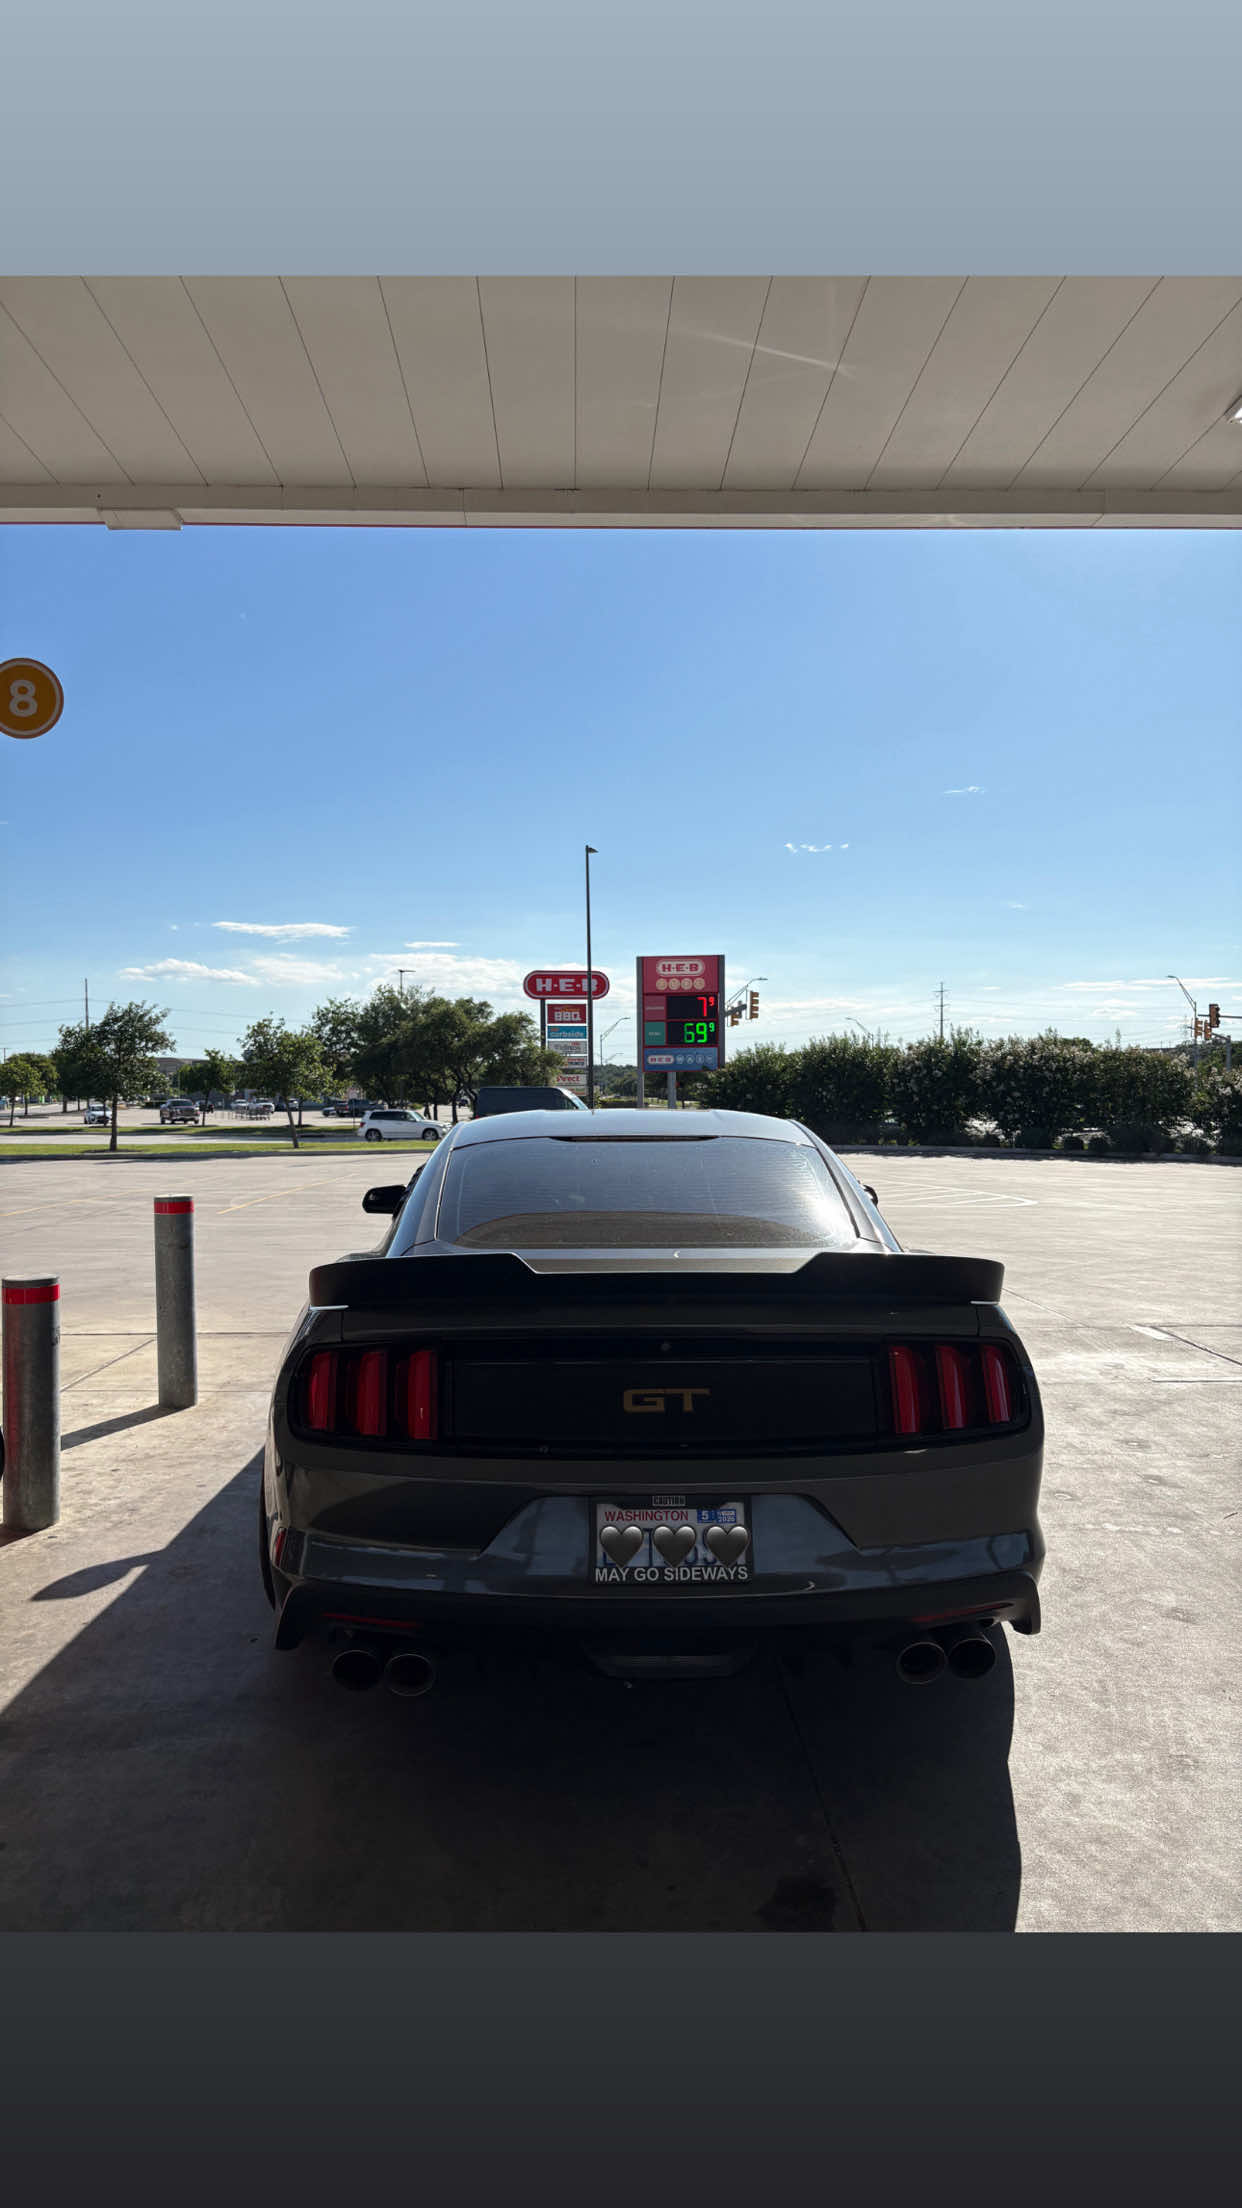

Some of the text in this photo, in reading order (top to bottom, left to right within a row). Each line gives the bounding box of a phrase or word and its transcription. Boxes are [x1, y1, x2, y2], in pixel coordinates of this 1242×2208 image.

[9, 679, 38, 717] 8
[553, 1011, 582, 1021] BBQ
[623, 1388, 711, 1412] GT
[604, 1510, 689, 1521] WASHINGTON
[701, 1510, 709, 1520] 5
[595, 1566, 748, 1582] MAY GO SIDEWAYS
